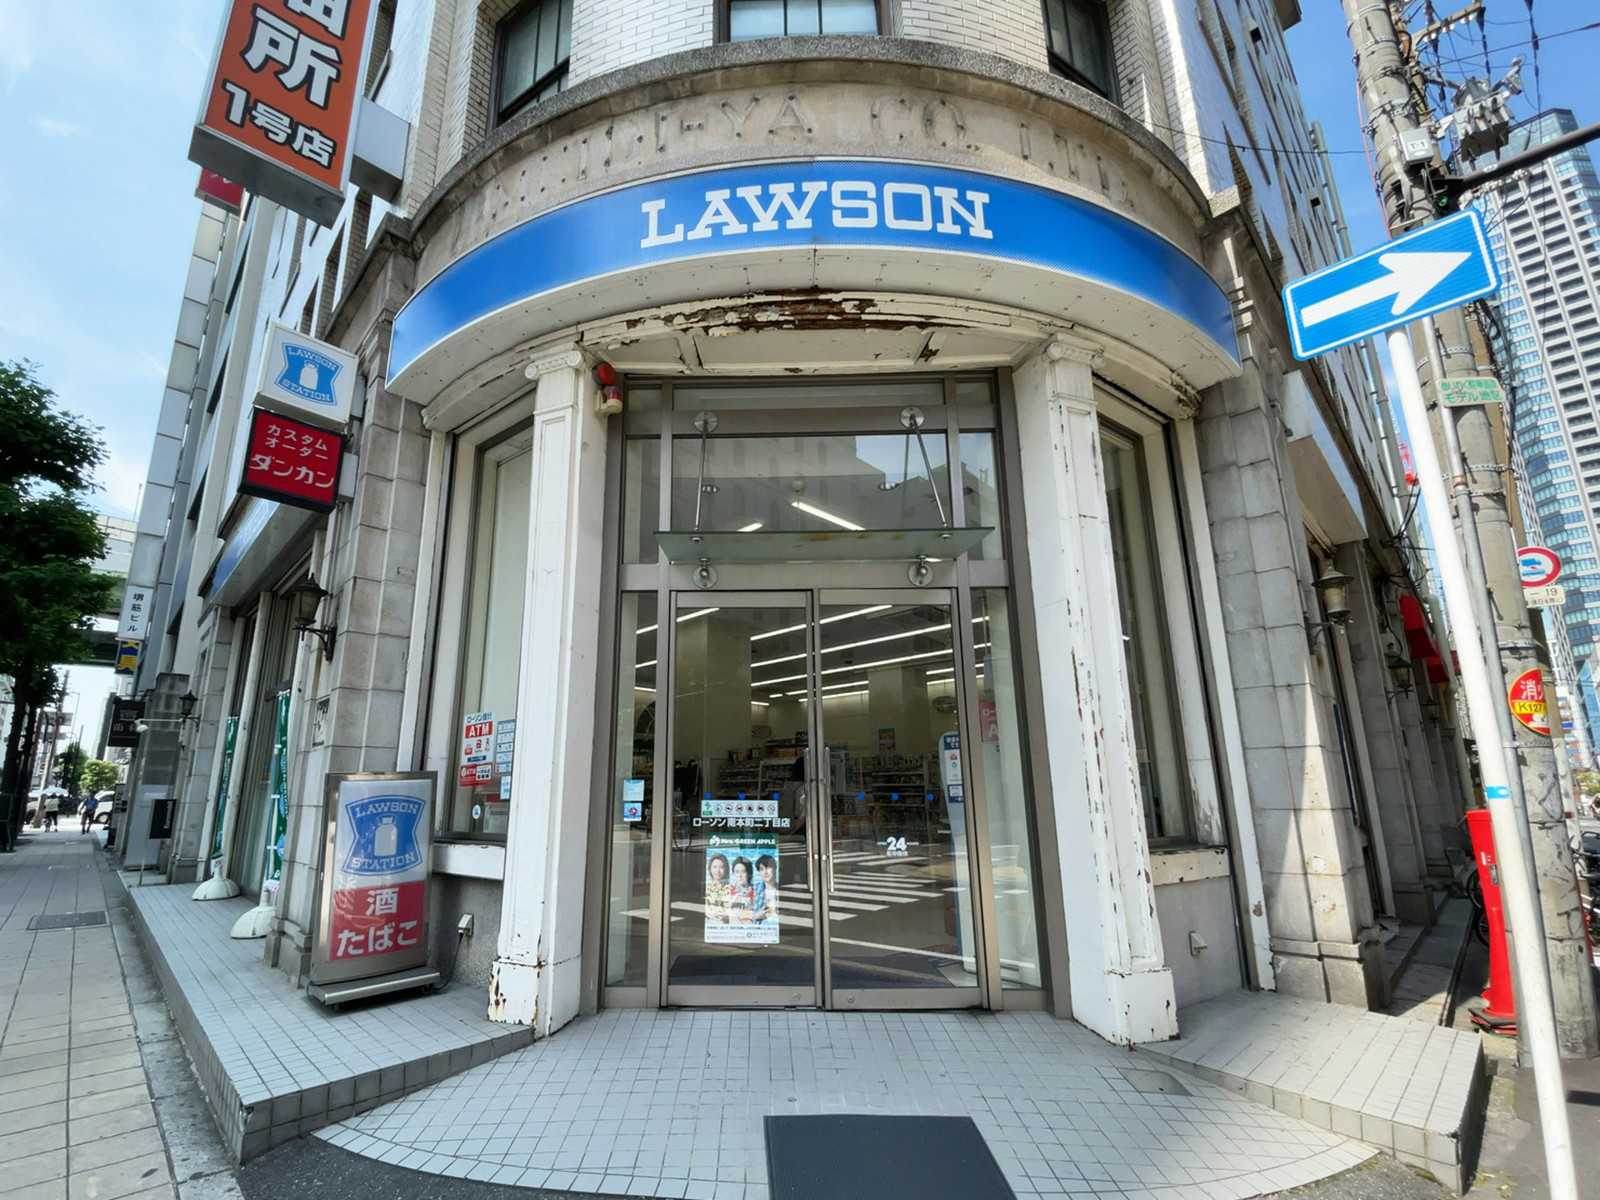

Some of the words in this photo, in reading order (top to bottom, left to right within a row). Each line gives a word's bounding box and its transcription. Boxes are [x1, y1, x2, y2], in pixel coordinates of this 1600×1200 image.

[222, 79, 335, 168] 1号店
[640, 180, 994, 248] LAWSON
[286, 346, 338, 372] LAWSON
[280, 378, 331, 402] STATION
[265, 436, 329, 460] オーダー
[267, 424, 328, 451] カスタム
[250, 453, 335, 488] ダンカン
[126, 592, 145, 632] 堺筋ビル
[468, 722, 490, 737] ATM
[355, 801, 419, 818] LAWSON
[886, 836, 907, 851] 24
[350, 851, 416, 870] STATION
[365, 887, 400, 917] 酒
[336, 919, 418, 957] たばこ
